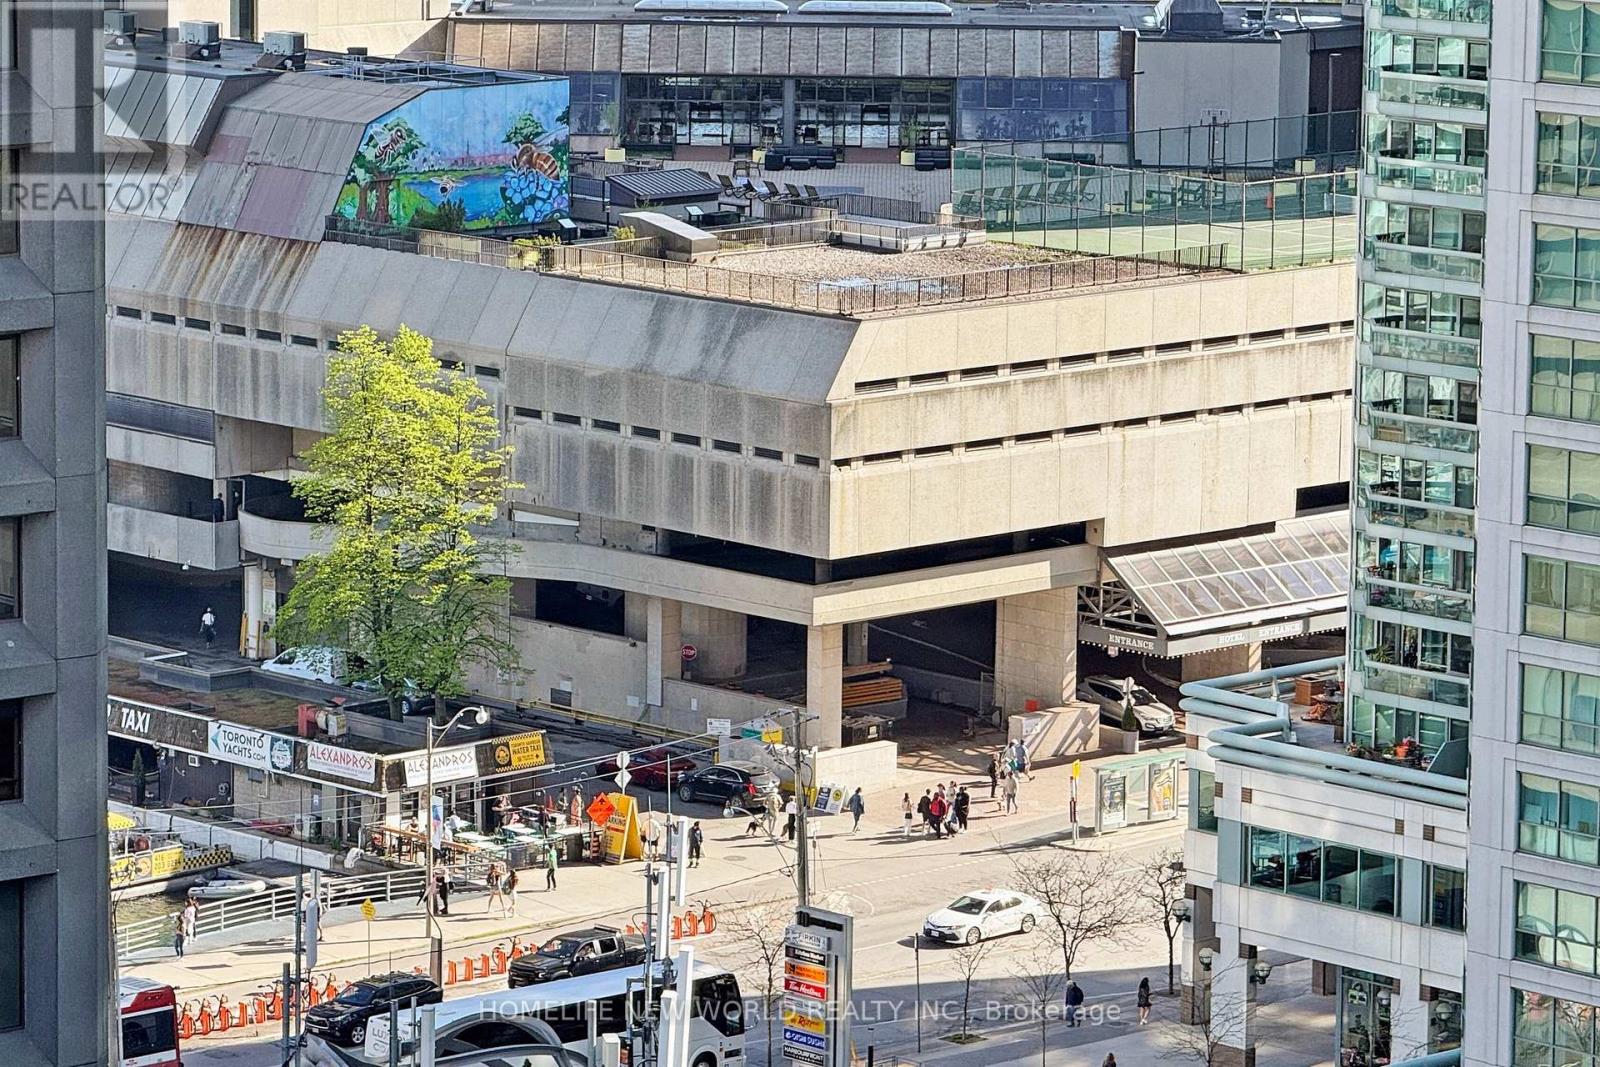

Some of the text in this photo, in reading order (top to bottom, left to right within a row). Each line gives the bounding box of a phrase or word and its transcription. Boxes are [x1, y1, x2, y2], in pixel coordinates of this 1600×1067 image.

[1108, 634, 1154, 650] ENTRANCE
[1218, 622, 1302, 644] HOTEL ENTRANCE
[121, 707, 151, 734] TAXI
[222, 730, 264, 749] TORONTO
[512, 744, 541, 755] WATER TAXI
[309, 745, 372, 770] ALEXANDROS
[407, 751, 473, 774] ALEANDROS
[789, 981, 822, 998] Tim Hortons
